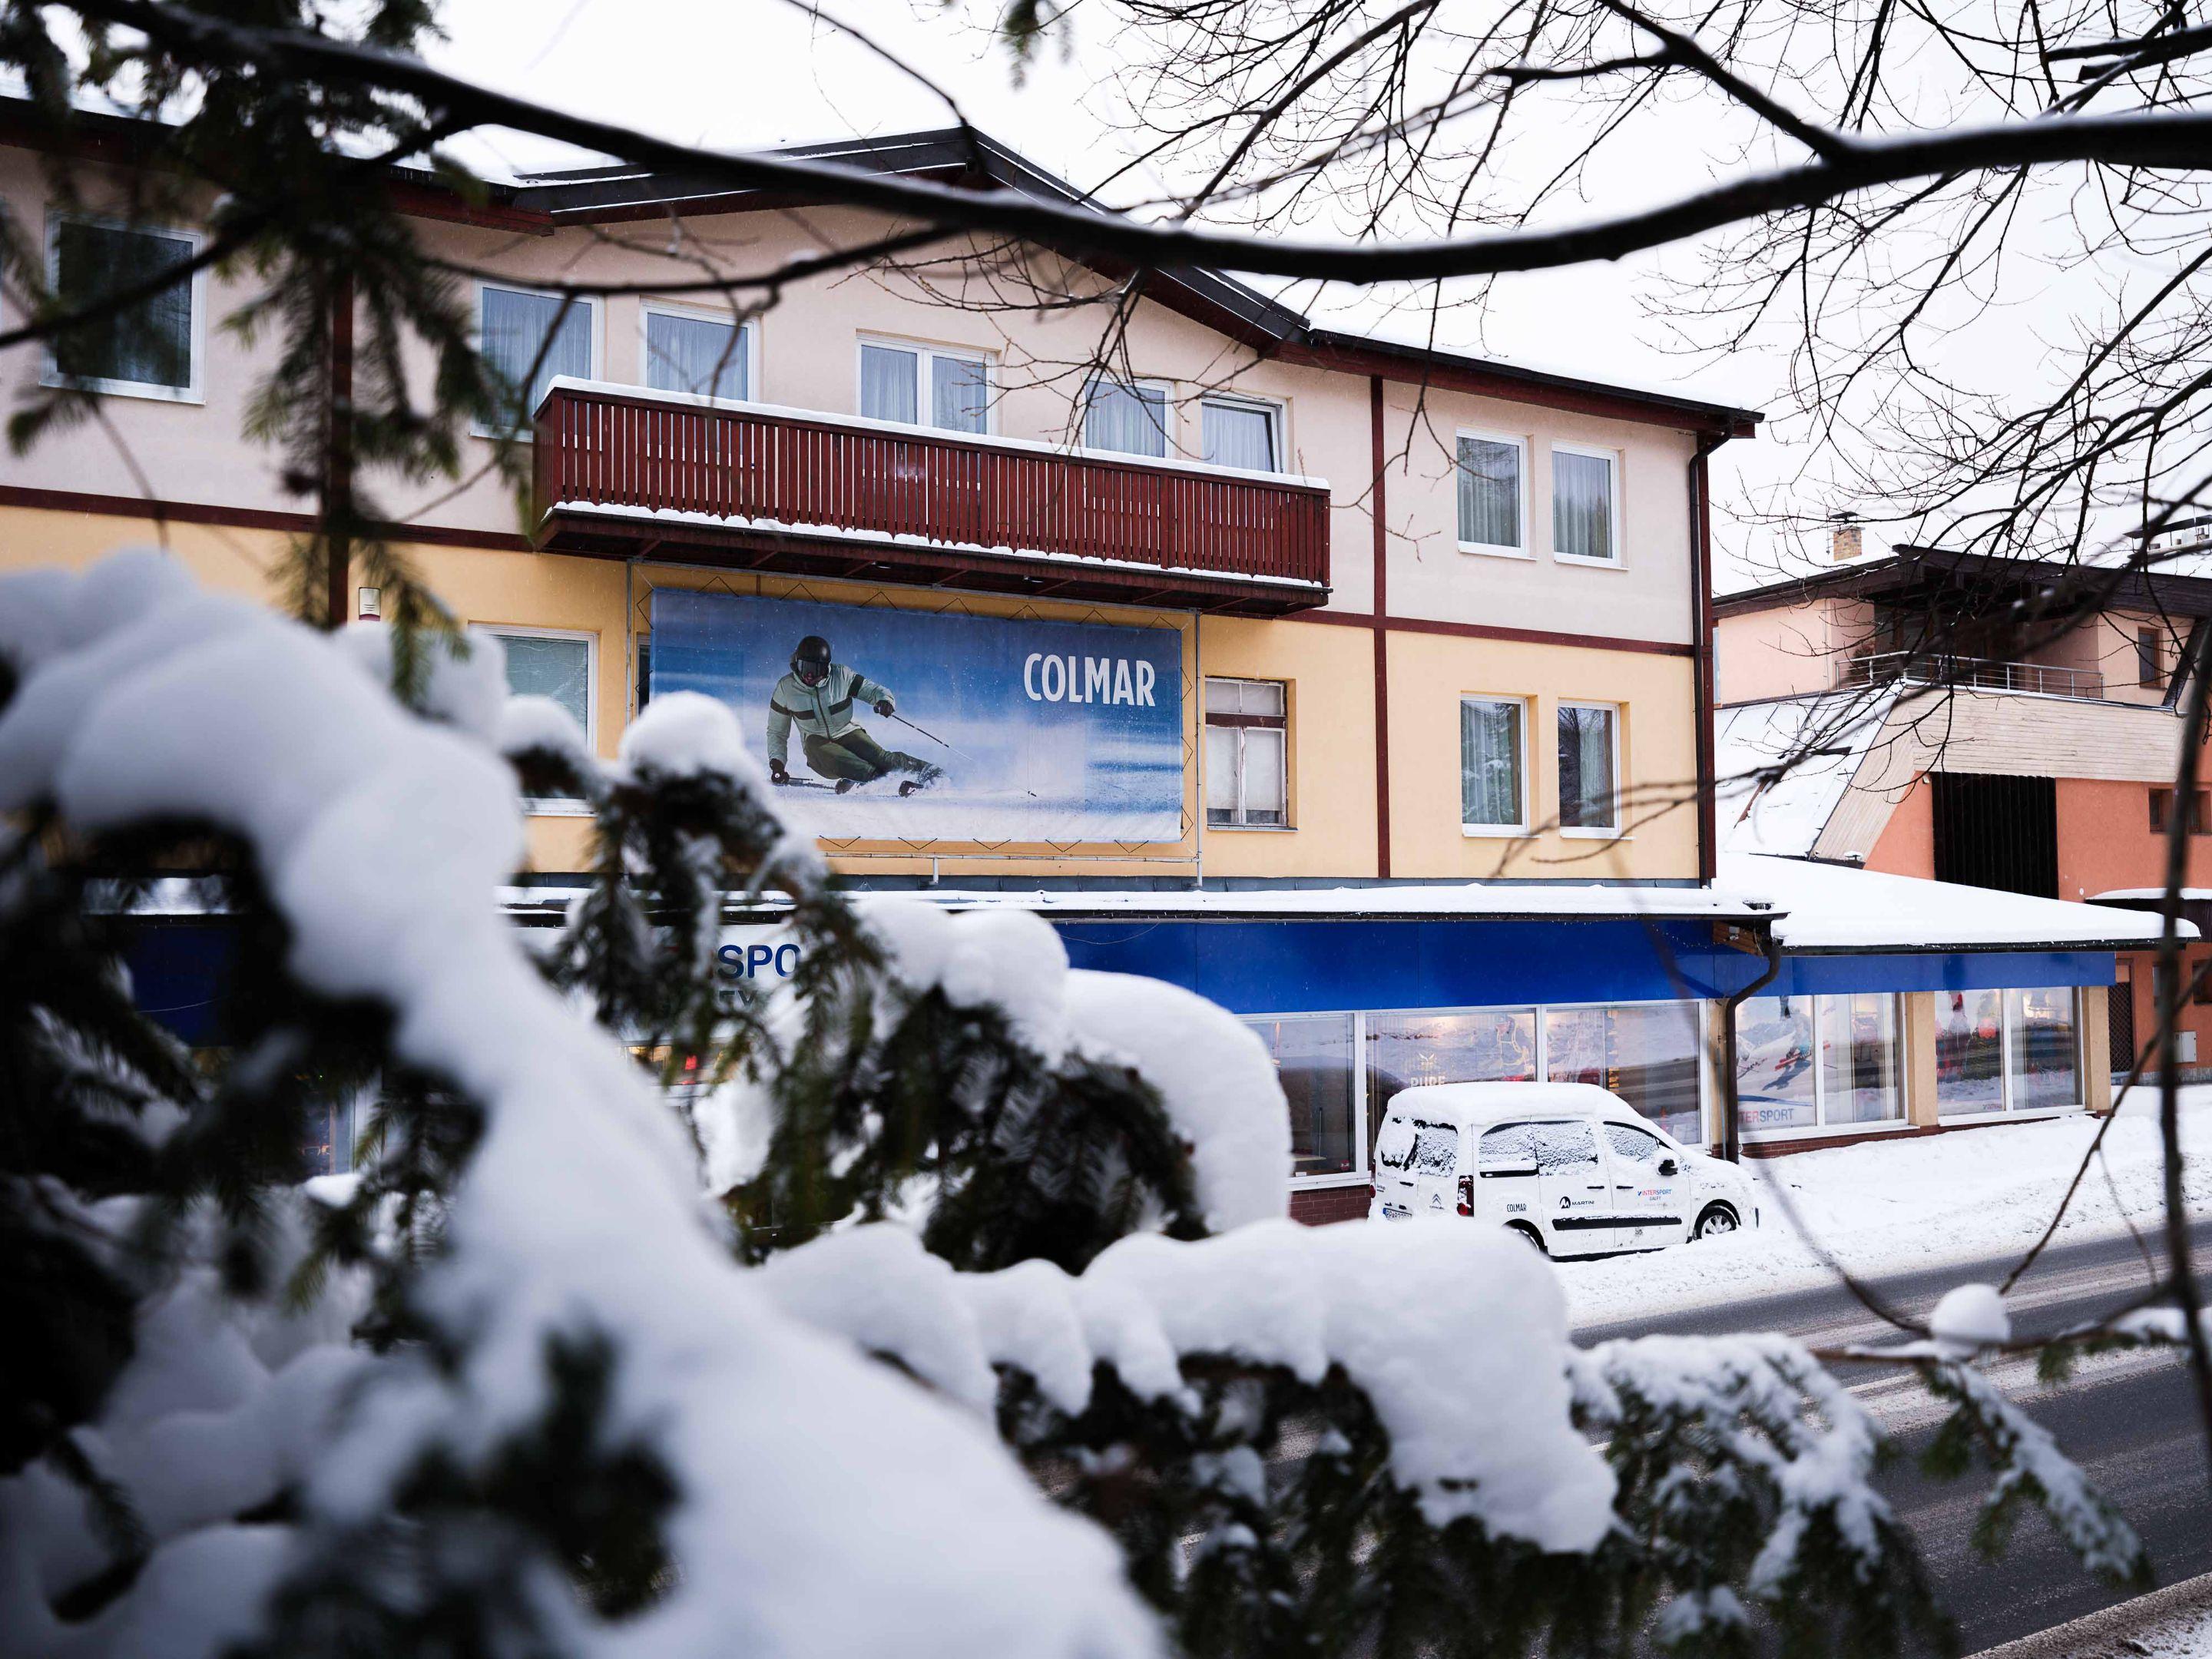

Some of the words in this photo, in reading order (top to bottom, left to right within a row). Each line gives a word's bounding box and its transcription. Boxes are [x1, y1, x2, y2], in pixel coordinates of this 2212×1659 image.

[1024, 653, 1155, 707] COLMAR
[1738, 1108, 1794, 1124] TERSPORT
[1506, 1203, 1527, 1213] COLMAR
